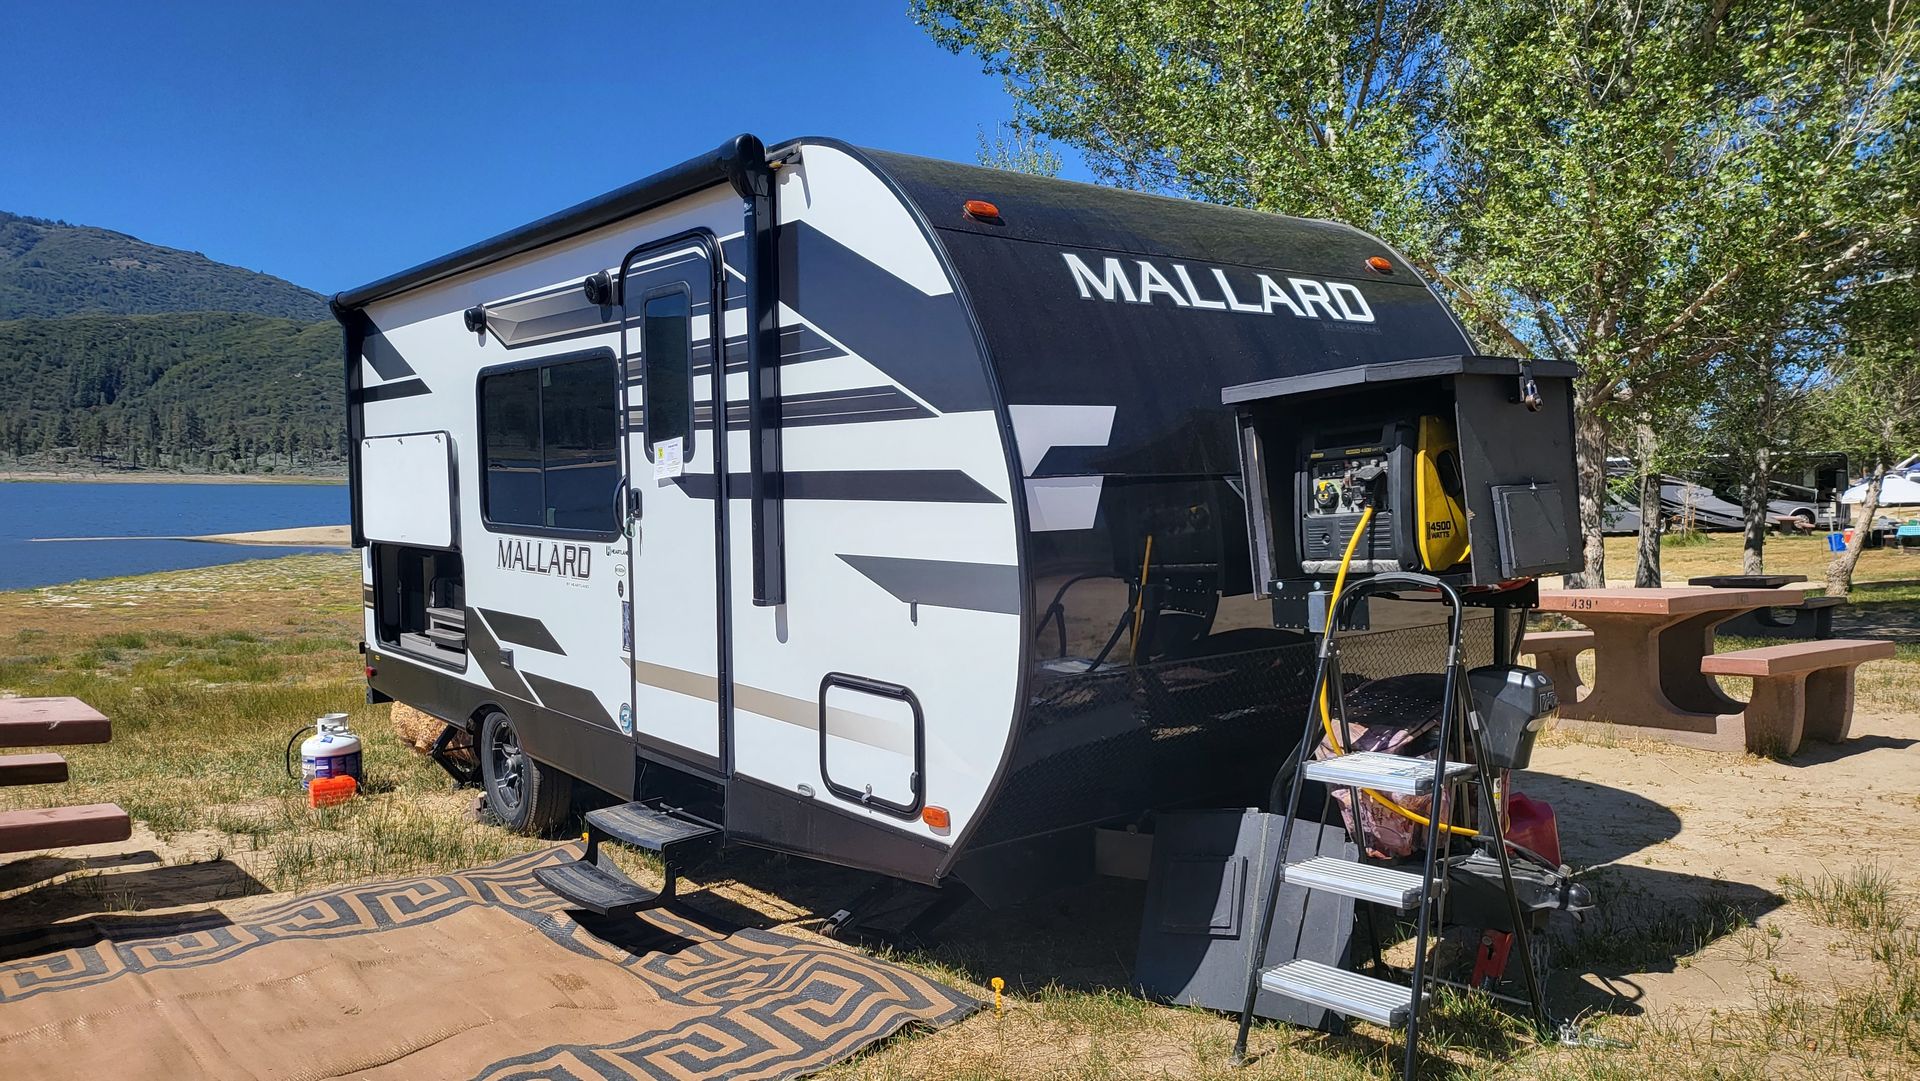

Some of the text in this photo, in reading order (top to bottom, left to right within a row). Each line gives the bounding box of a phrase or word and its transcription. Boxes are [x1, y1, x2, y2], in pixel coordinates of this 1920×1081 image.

[1062, 253, 1376, 323] MALLARD
[1430, 521, 1451, 531] 4500
[1431, 531, 1450, 539] WATTS
[497, 538, 591, 580] MALLARD
[1571, 598, 1592, 610] 439
